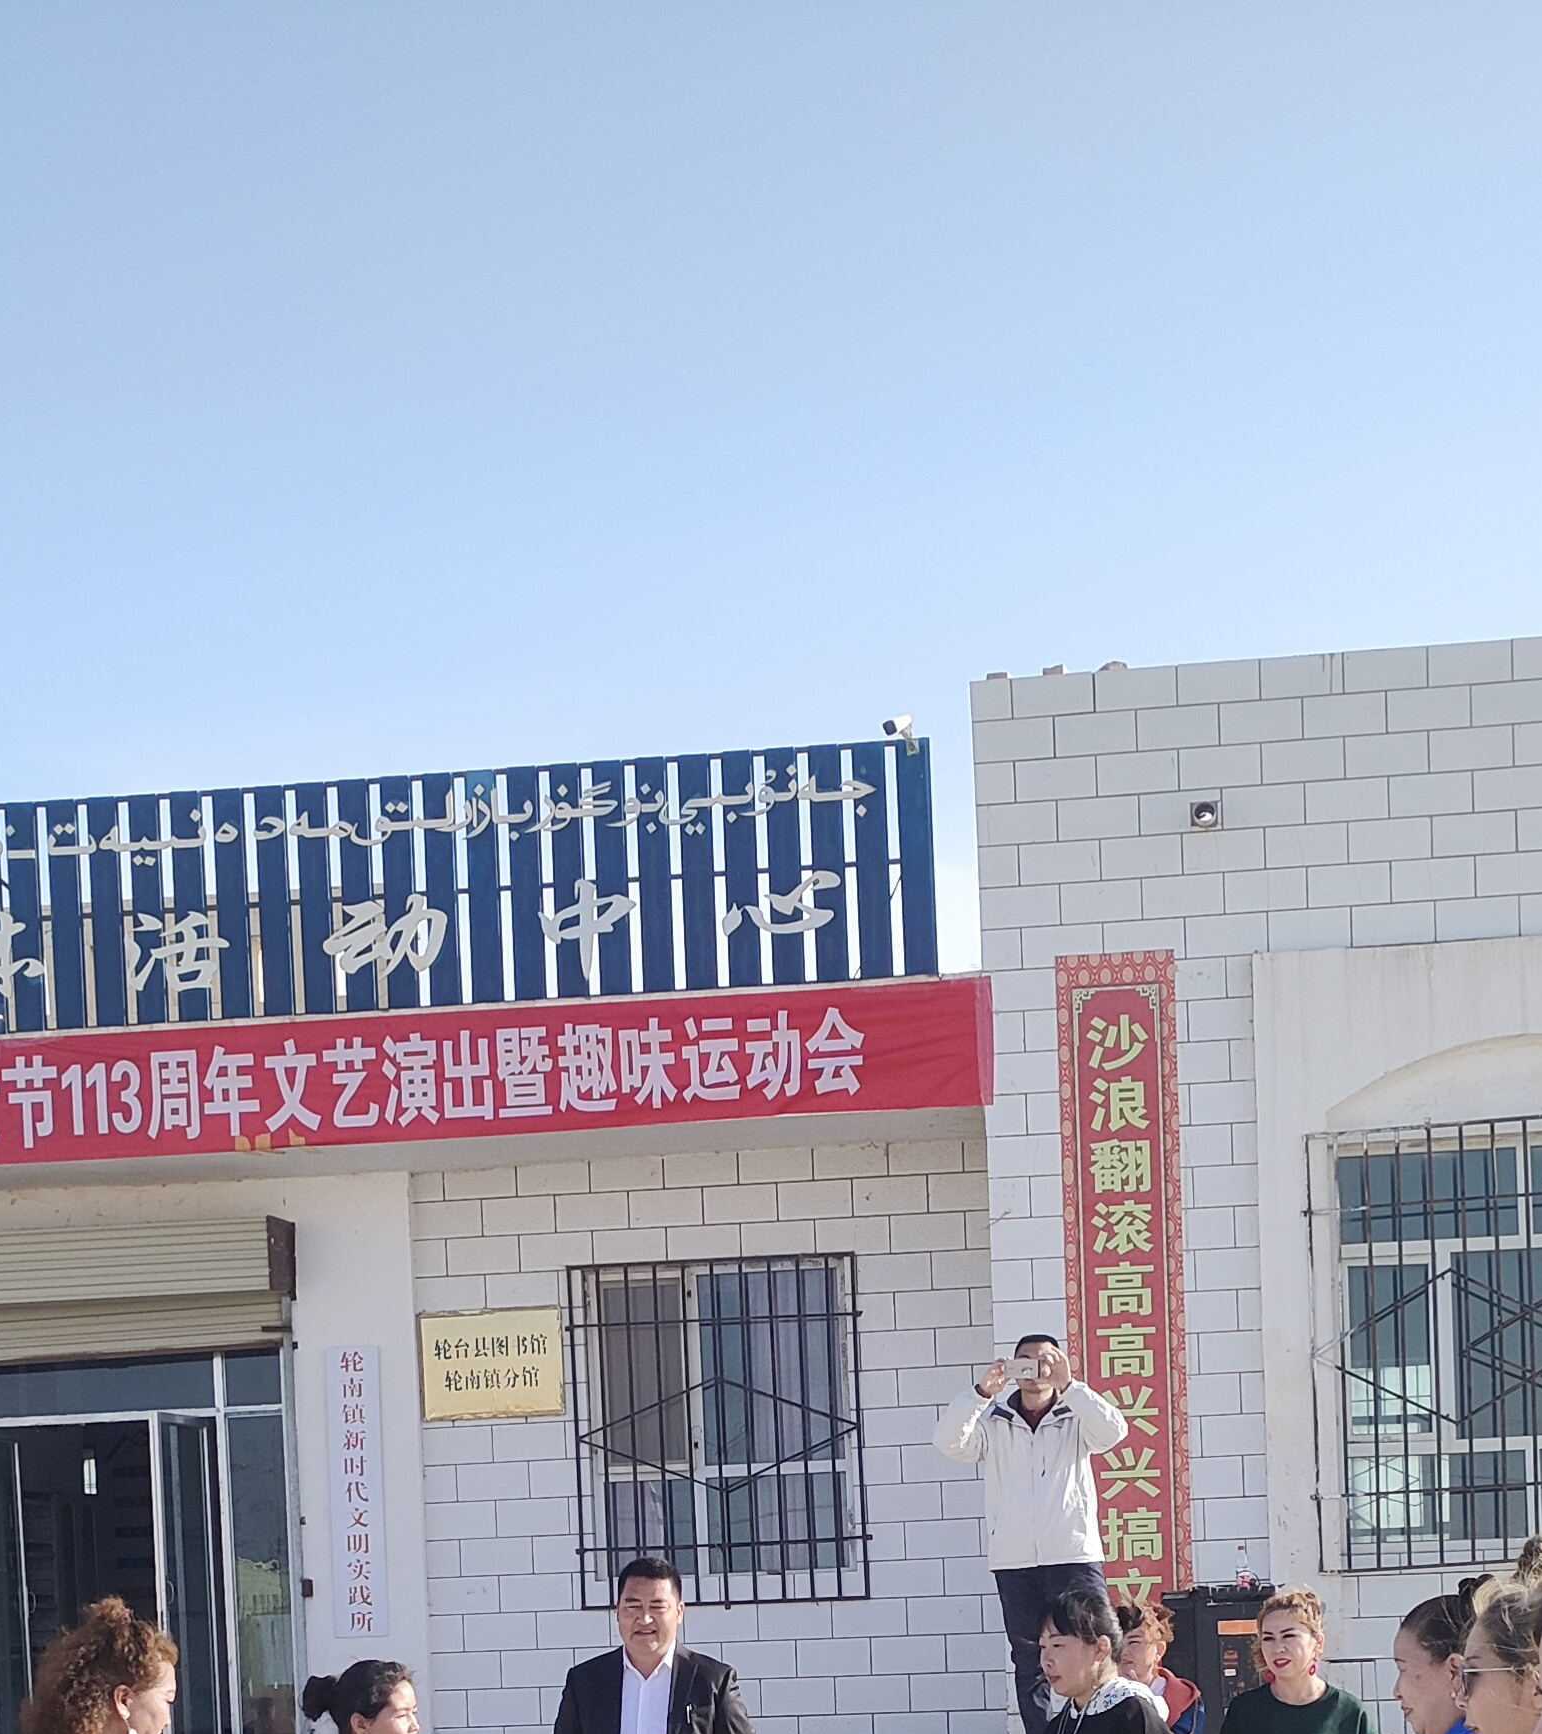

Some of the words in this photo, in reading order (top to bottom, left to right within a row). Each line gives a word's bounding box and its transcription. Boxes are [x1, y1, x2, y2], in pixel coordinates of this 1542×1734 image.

[433, 1333, 548, 1361] 轮台县图书馆
[444, 1365, 540, 1393] 轮南镇分馆
[339, 1350, 373, 1634] 轮南镇新时代文明实践所
